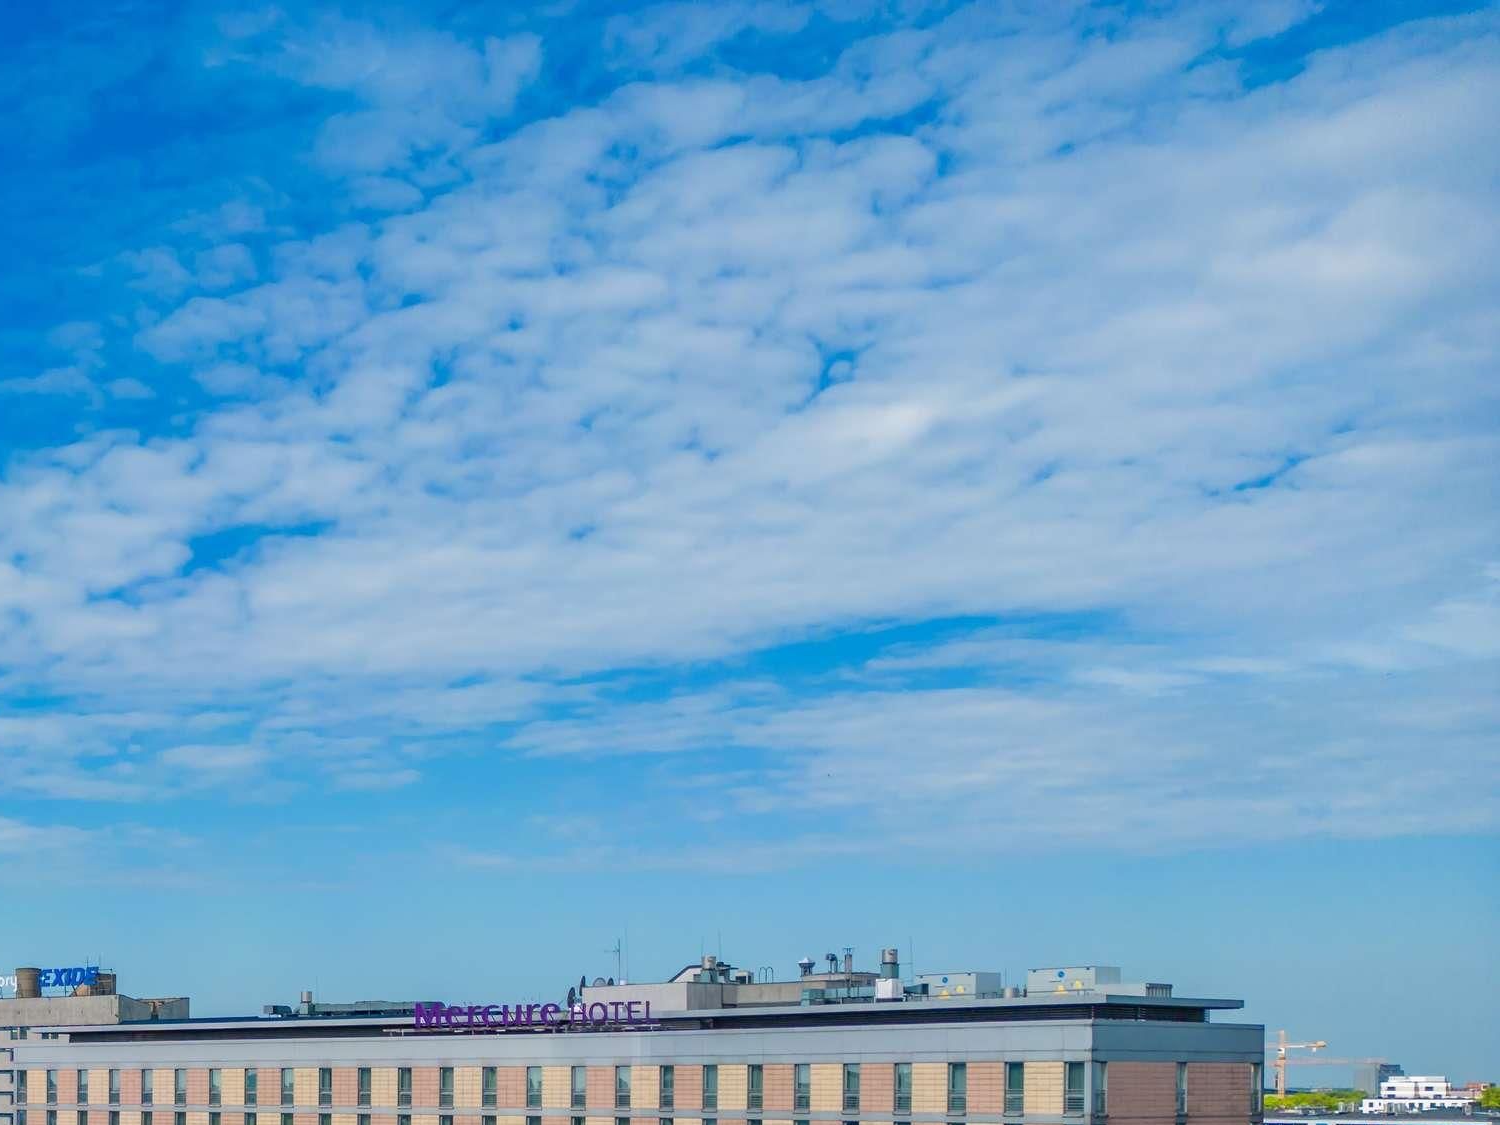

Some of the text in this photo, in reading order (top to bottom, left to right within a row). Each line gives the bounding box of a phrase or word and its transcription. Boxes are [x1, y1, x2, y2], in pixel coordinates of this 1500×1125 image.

[40, 966, 99, 987] EXIDE
[414, 1001, 660, 1028] Mercure HOTEL
